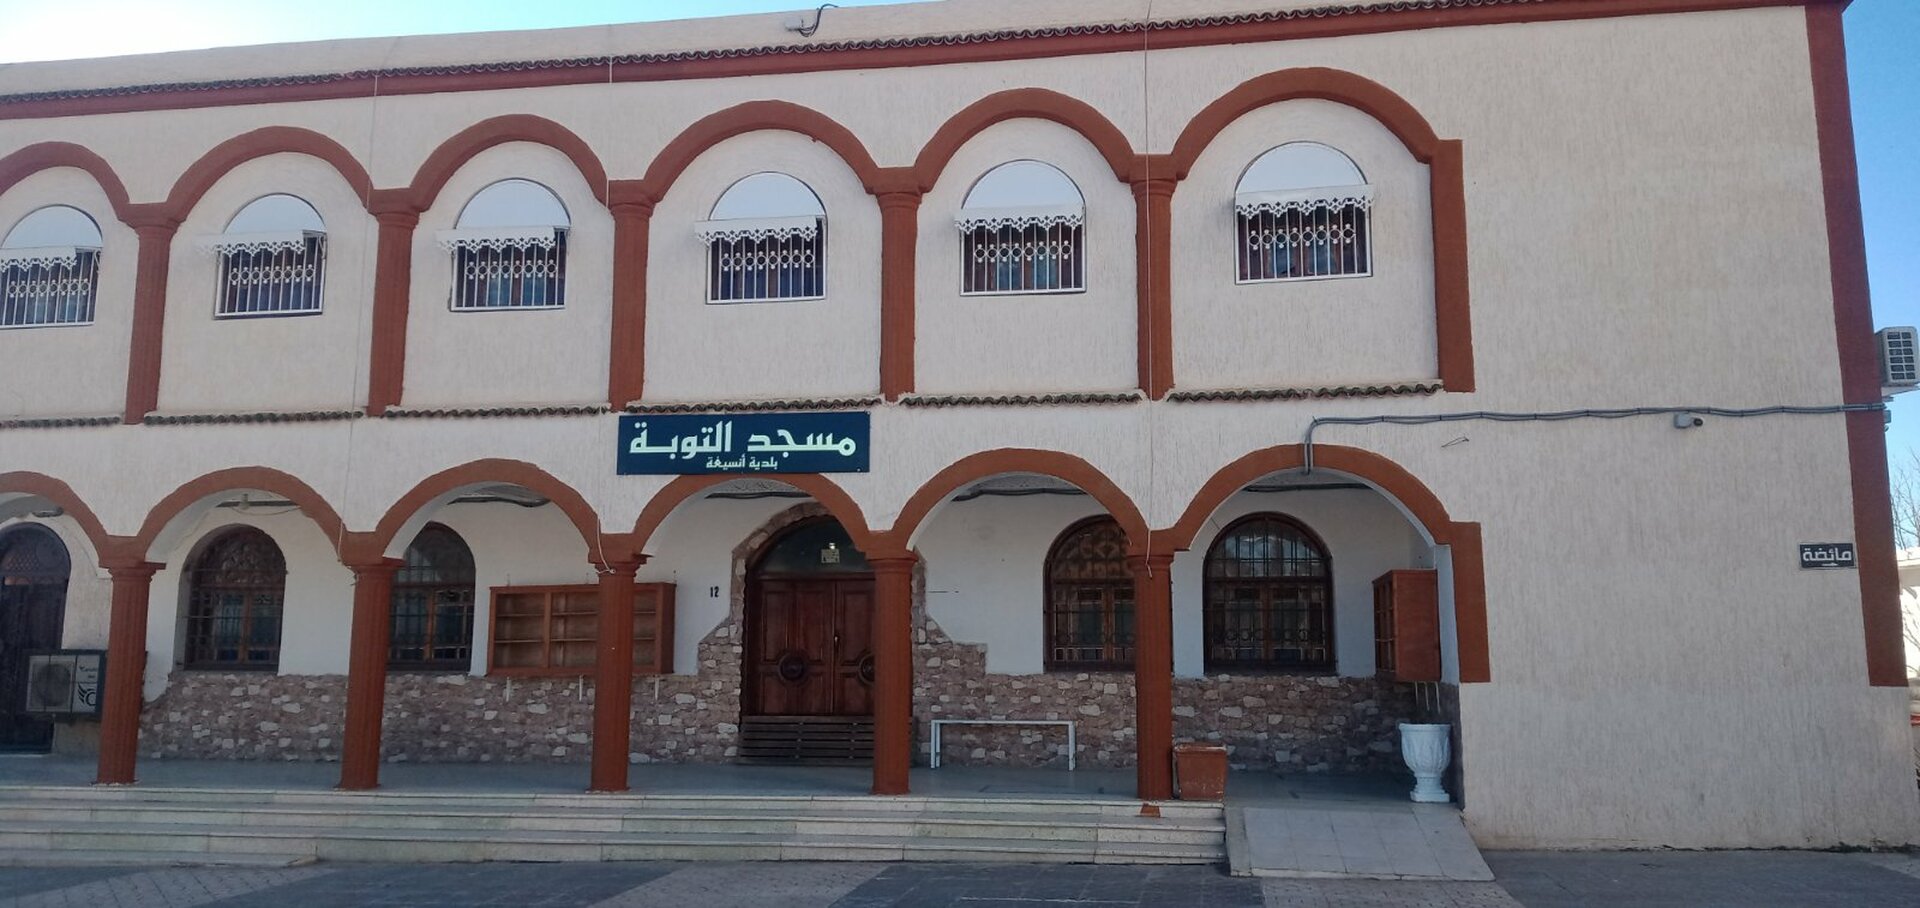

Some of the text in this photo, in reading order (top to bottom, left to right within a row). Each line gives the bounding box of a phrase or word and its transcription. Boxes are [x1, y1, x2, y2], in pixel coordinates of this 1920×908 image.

[629, 421, 857, 459] مسجد التوبة
[706, 455, 778, 470] بلدية أنسيغة
[1803, 547, 1852, 562] مائضة
[710, 586, 719, 598] 12
